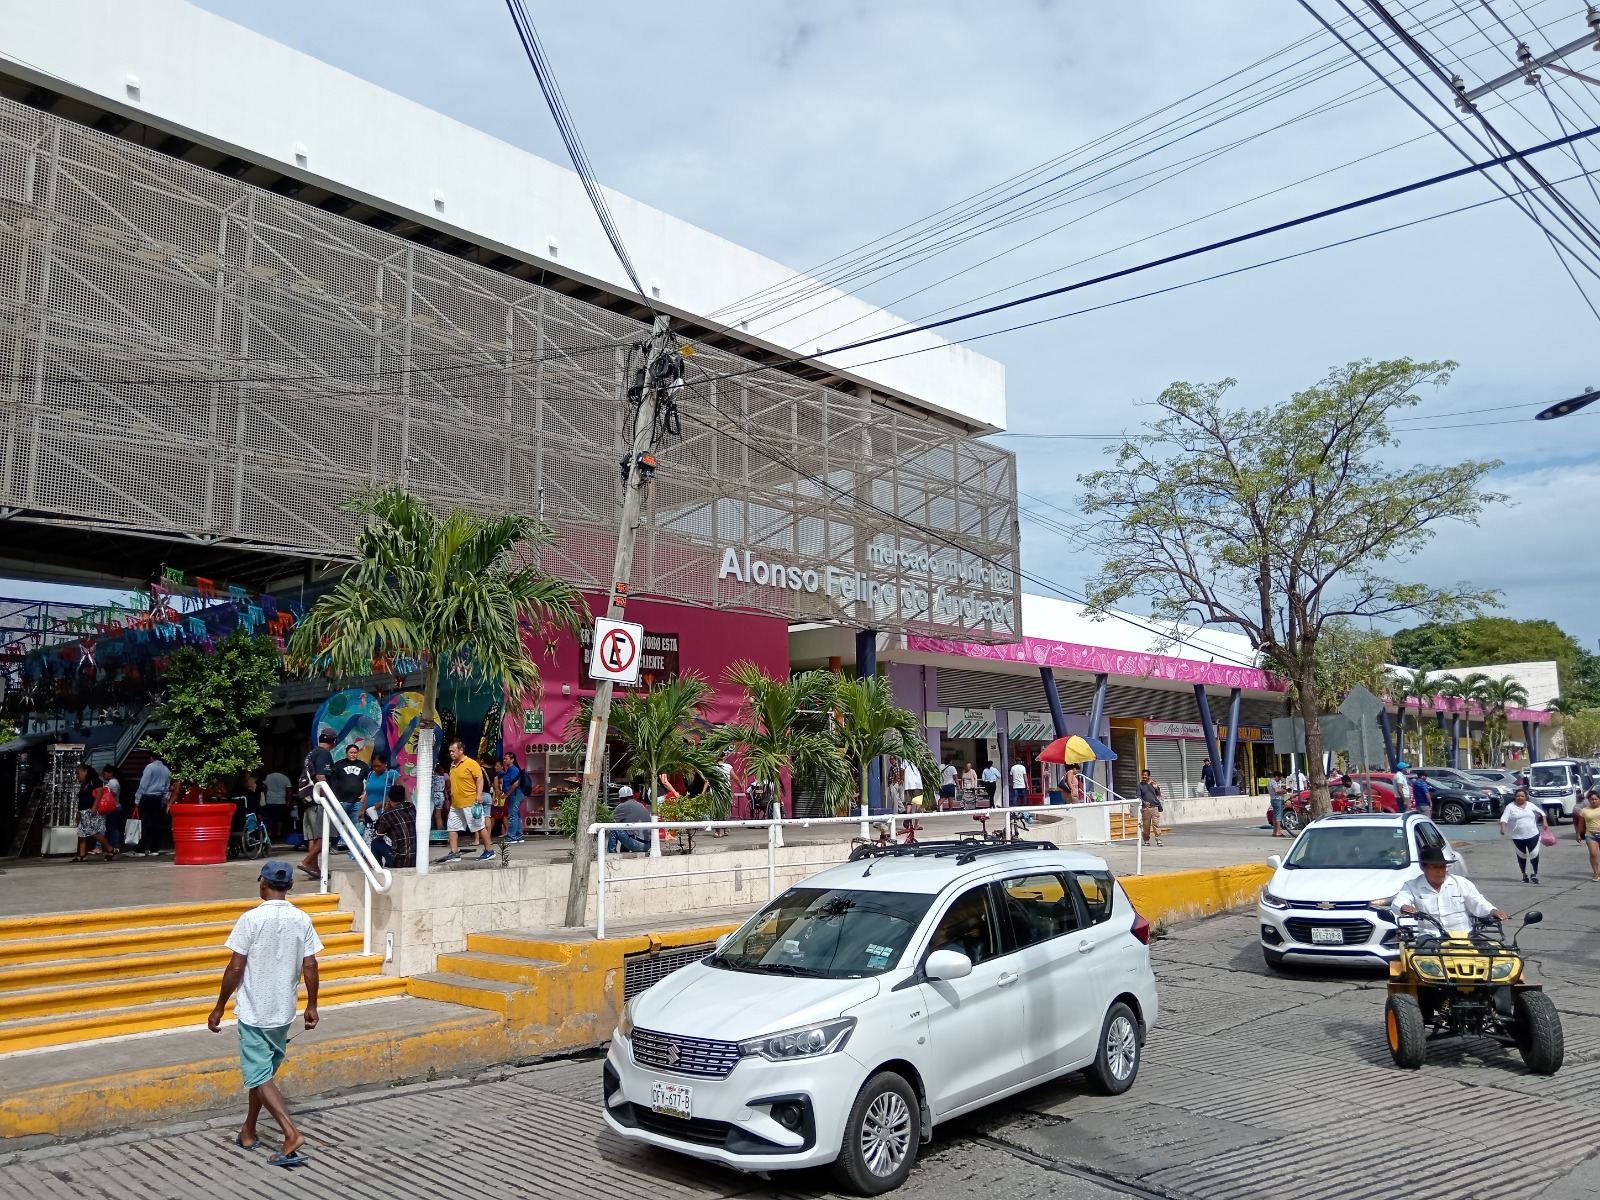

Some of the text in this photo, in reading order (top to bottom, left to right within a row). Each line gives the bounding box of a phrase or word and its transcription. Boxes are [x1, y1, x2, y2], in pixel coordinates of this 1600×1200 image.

[719, 547, 1014, 624] Alonso Felipe de Andrade
[868, 543, 1013, 589] mercado municipal
[662, 637, 678, 652] ESTA
